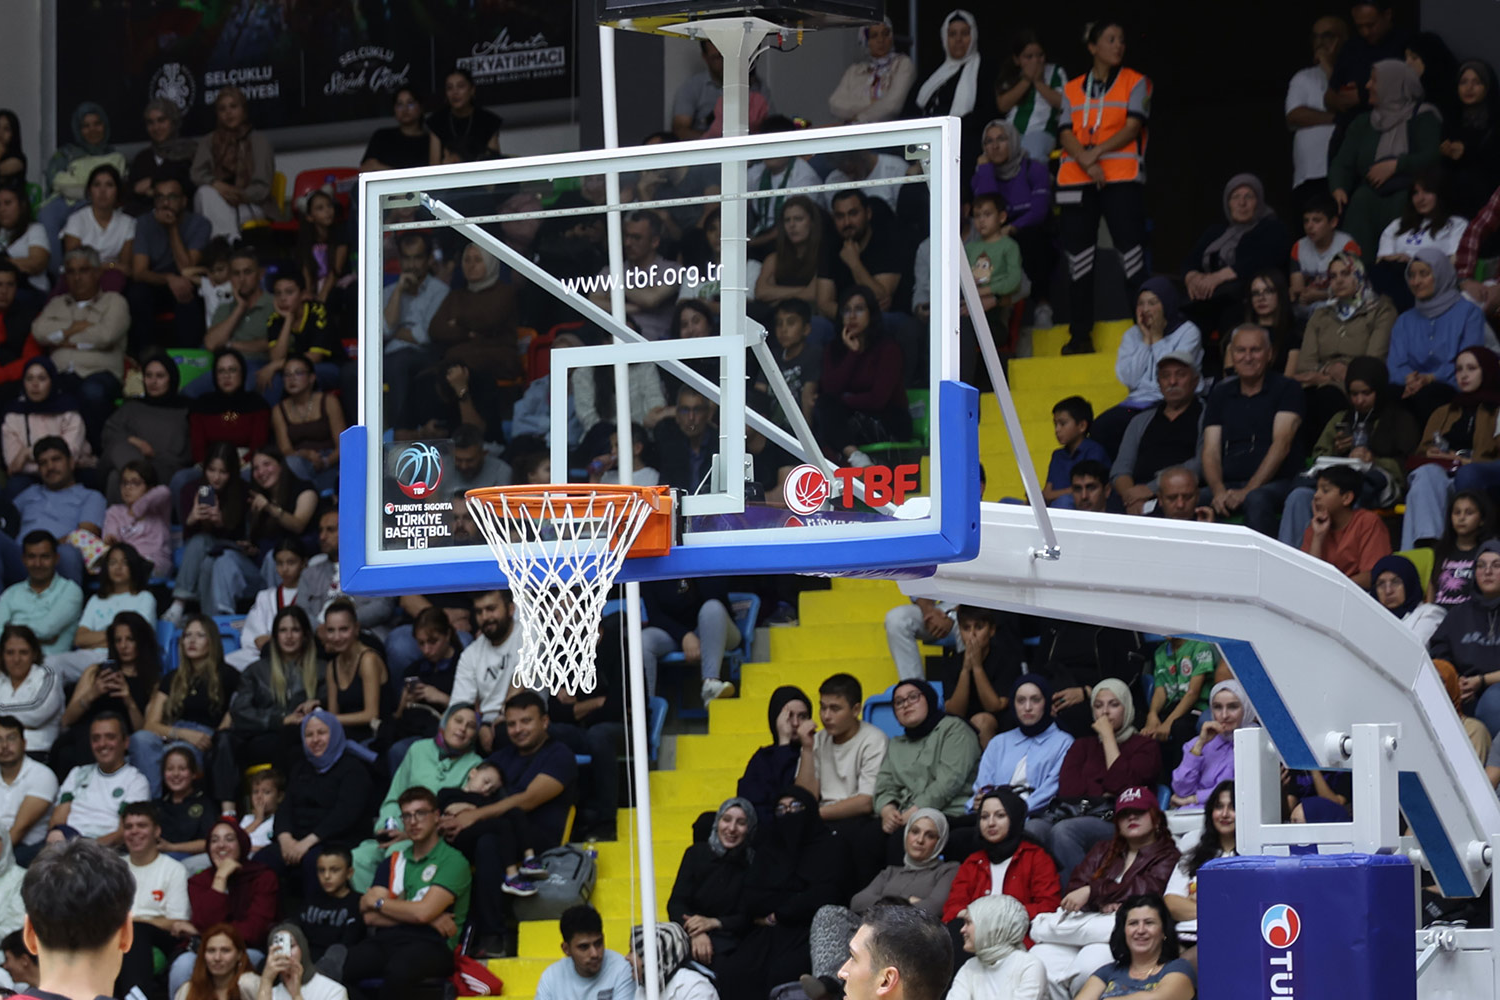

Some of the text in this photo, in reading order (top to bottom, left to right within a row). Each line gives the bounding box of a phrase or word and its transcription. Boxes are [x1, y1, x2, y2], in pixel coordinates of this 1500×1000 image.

[204, 65, 273, 87] SELÇUKLU
[560, 261, 724, 295] www.tbf.org.tr
[833, 464, 919, 508] TBF
[395, 512, 443, 526] TÜRKİYE
[385, 525, 451, 539] BASKETBOL
[407, 536, 428, 549] LİGİ
